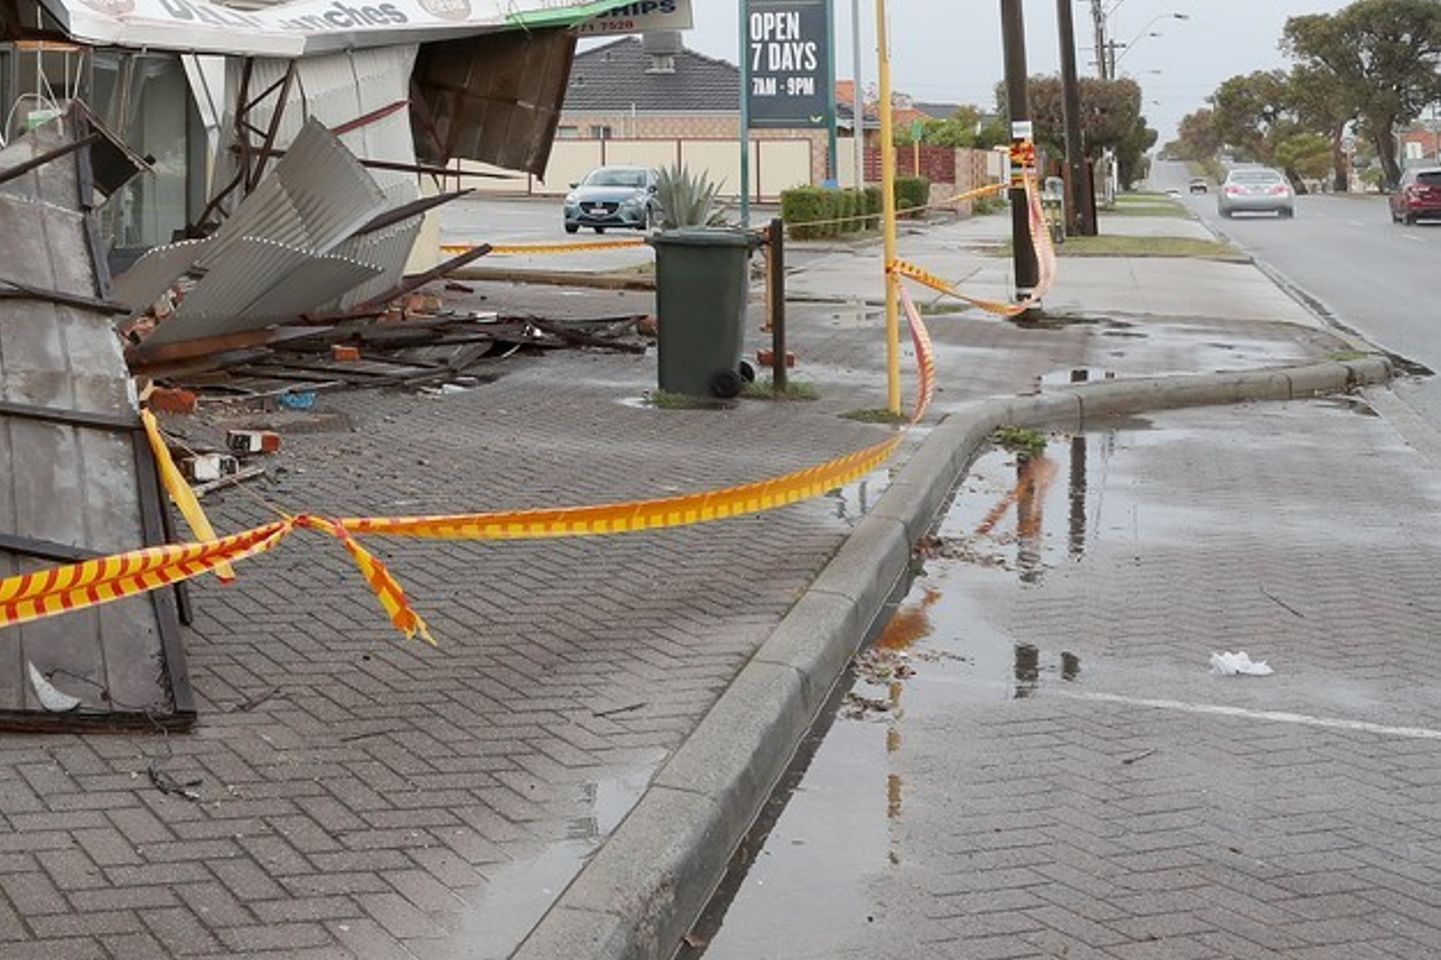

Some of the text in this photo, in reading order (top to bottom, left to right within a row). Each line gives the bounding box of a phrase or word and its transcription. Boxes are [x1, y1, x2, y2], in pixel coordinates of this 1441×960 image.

[750, 12, 800, 40] OPEN
[751, 42, 817, 72] 7 DAYS
[753, 77, 776, 95] 7AM
[787, 77, 815, 95] 9PM
